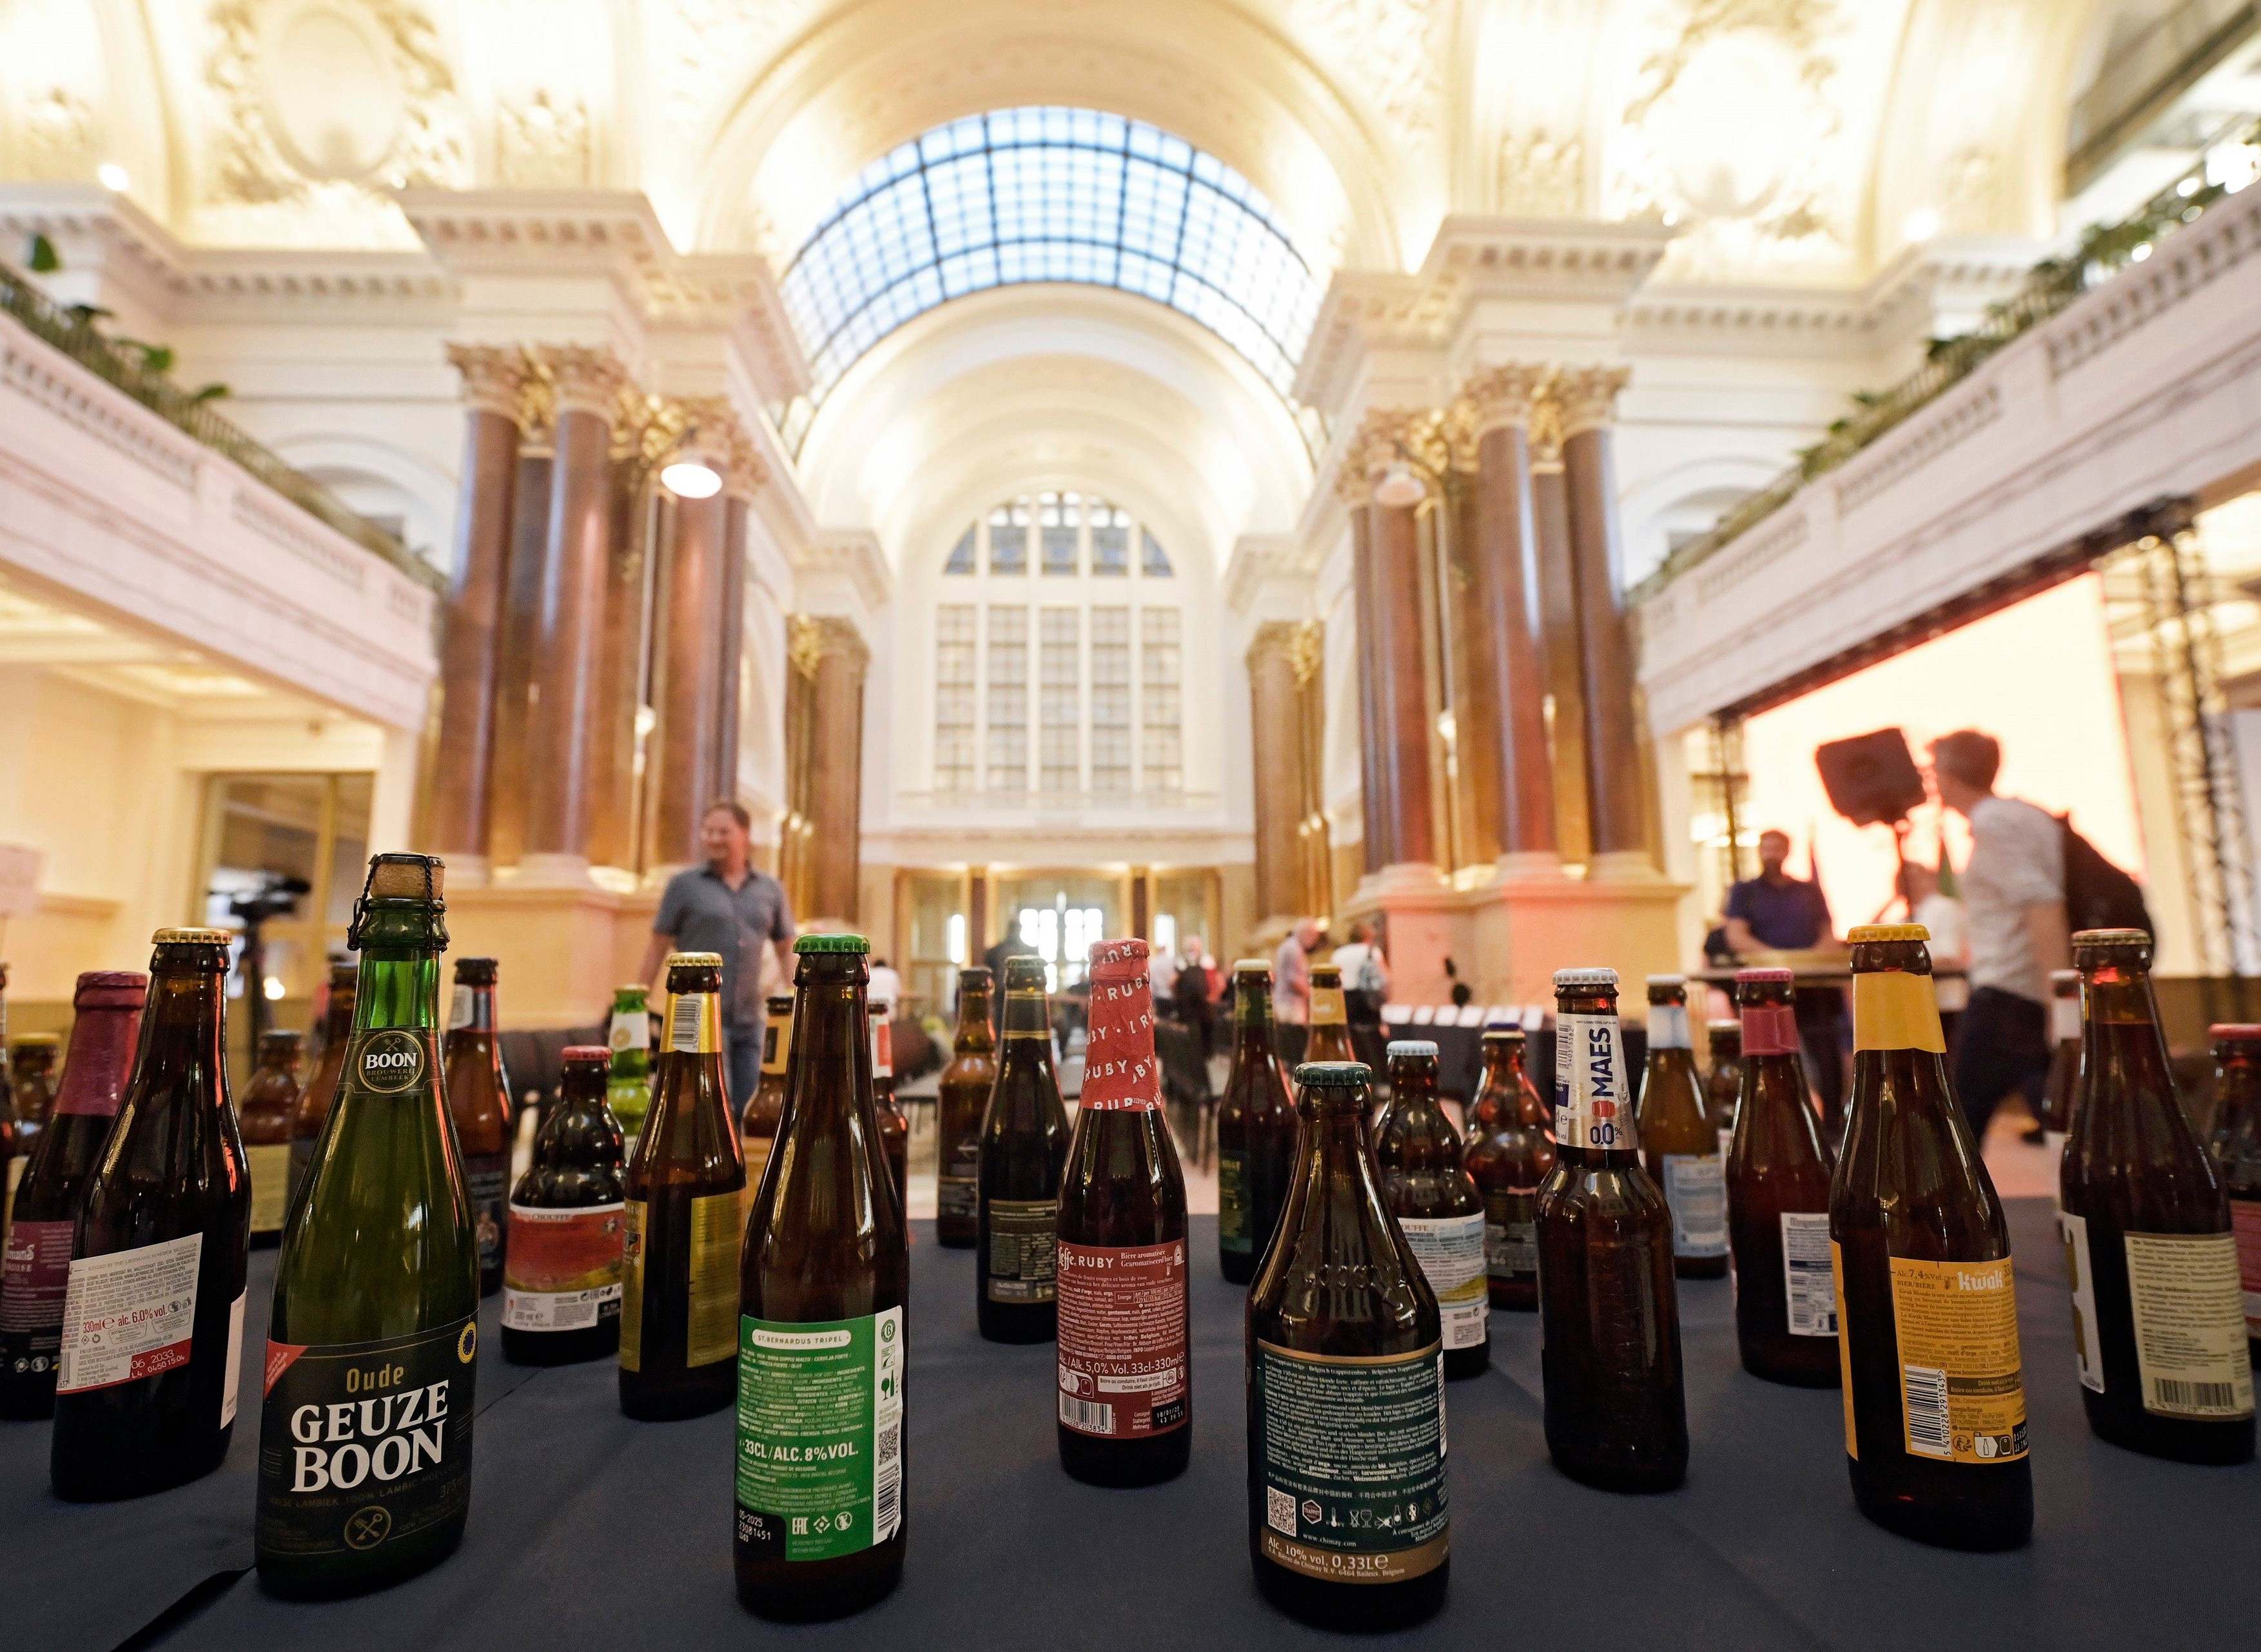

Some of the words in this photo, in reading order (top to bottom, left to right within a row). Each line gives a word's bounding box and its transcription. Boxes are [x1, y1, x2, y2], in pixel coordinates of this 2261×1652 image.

[365, 1053, 417, 1069] BOON
[1086, 1060, 1127, 1081] RUBY
[1589, 1027, 1614, 1097] MAES
[1079, 1256, 1114, 1268] RUBY
[1957, 1269, 2003, 1291] Kwak
[118, 1315, 131, 1326] alc.
[132, 1308, 153, 1323] 6,0%
[154, 1305, 168, 1317] vol.
[131, 1359, 145, 1369] 06
[151, 1350, 174, 1364] 2033
[1086, 1361, 1109, 1375] 5,0%
[1111, 1363, 1129, 1374] Vol.
[346, 1364, 404, 1393] Oude
[1938, 1378, 1948, 1409] 291343
[291, 1379, 449, 1443] GEUZE
[1082, 1423, 1105, 1433] 203834
[1941, 1414, 1950, 1445] 410228
[291, 1418, 447, 1492] BOON
[1303, 1533, 1356, 1547] www.chimay.com
[1268, 1537, 1282, 1551] Alc.
[1286, 1545, 1307, 1560] 10%
[1310, 1555, 1328, 1566] vol.
[1332, 1555, 1374, 1570] 0,33L
[1301, 1562, 1322, 1573] Chimay
